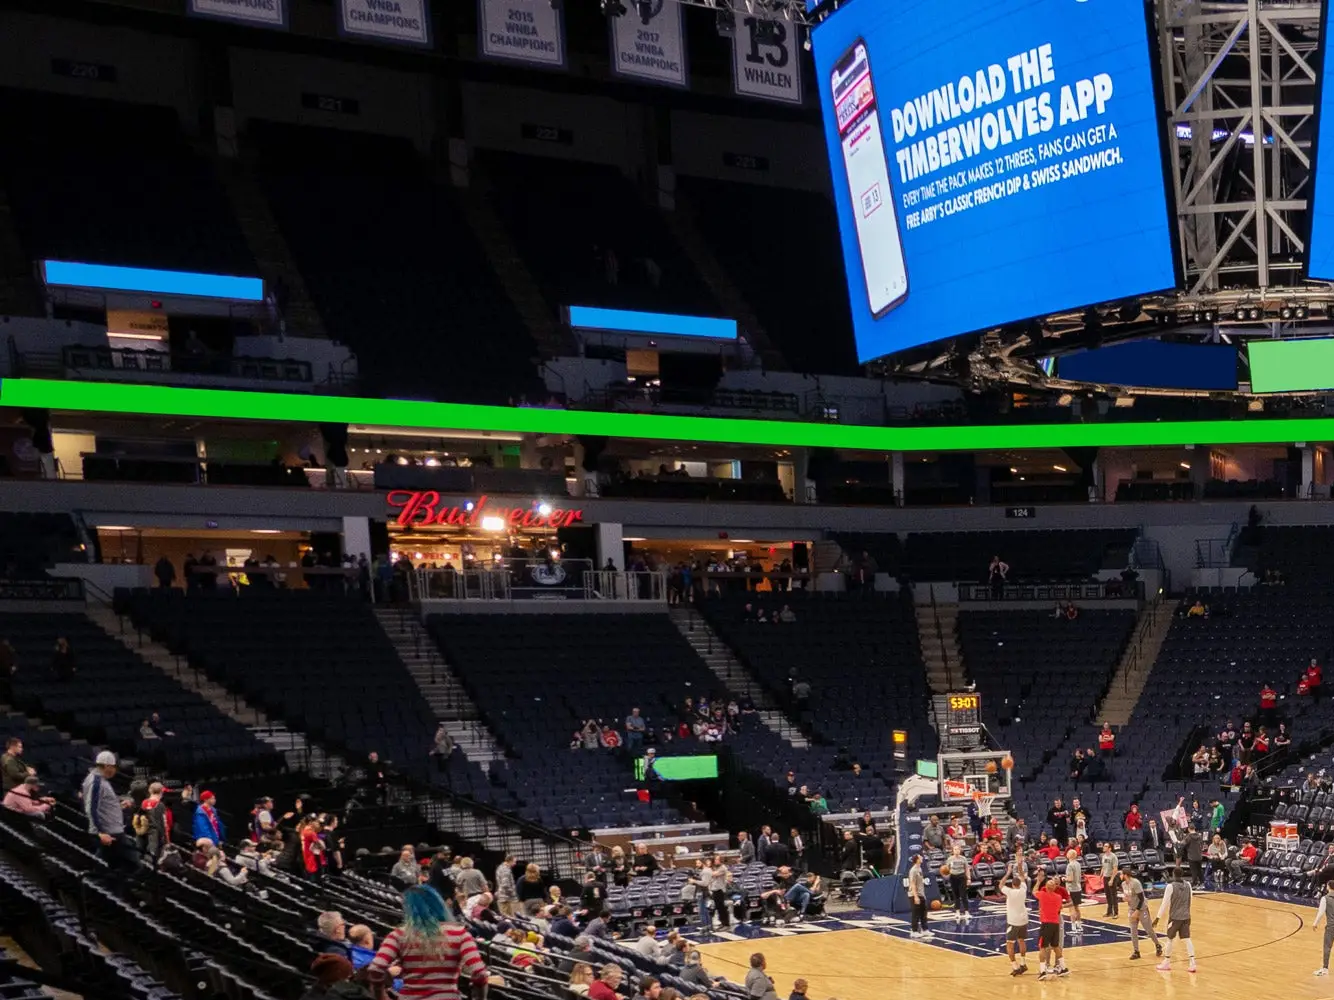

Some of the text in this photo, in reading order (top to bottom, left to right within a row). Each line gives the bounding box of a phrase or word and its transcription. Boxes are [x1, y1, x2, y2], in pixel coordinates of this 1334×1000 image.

[366, 0, 402, 14] WNBA
[508, 8, 534, 23] 2015
[350, 9, 420, 30] CHAMPIONS
[505, 23, 538, 37] WNBA
[489, 33, 555, 53] CHAMPIONS
[634, 42, 665, 57] WNBA
[620, 52, 680, 73] CHAMPIONS
[744, 67, 792, 89] WHALEN
[891, 64, 1006, 143] DOWNLOAD
[1007, 43, 1055, 93] THE
[896, 92, 1054, 183] TIMBERWOLVES
[1059, 73, 1114, 126] APP
[903, 122, 1118, 209] EVERY TIME THE PACK MAKES 12 THREES, FANS CAN GET A
[906, 212, 920, 230] FREE
[944, 193, 974, 216] CLASSIC
[973, 183, 1005, 206] FRENCH
[1006, 178, 1021, 196] DIP
[1022, 176, 1030, 191] &
[1031, 165, 1060, 188] SWISS
[1061, 146, 1124, 177] SANDWICH.
[386, 489, 583, 528] Budeiser
[1013, 508, 1028, 517] 124
[950, 697, 977, 709] 53:07
